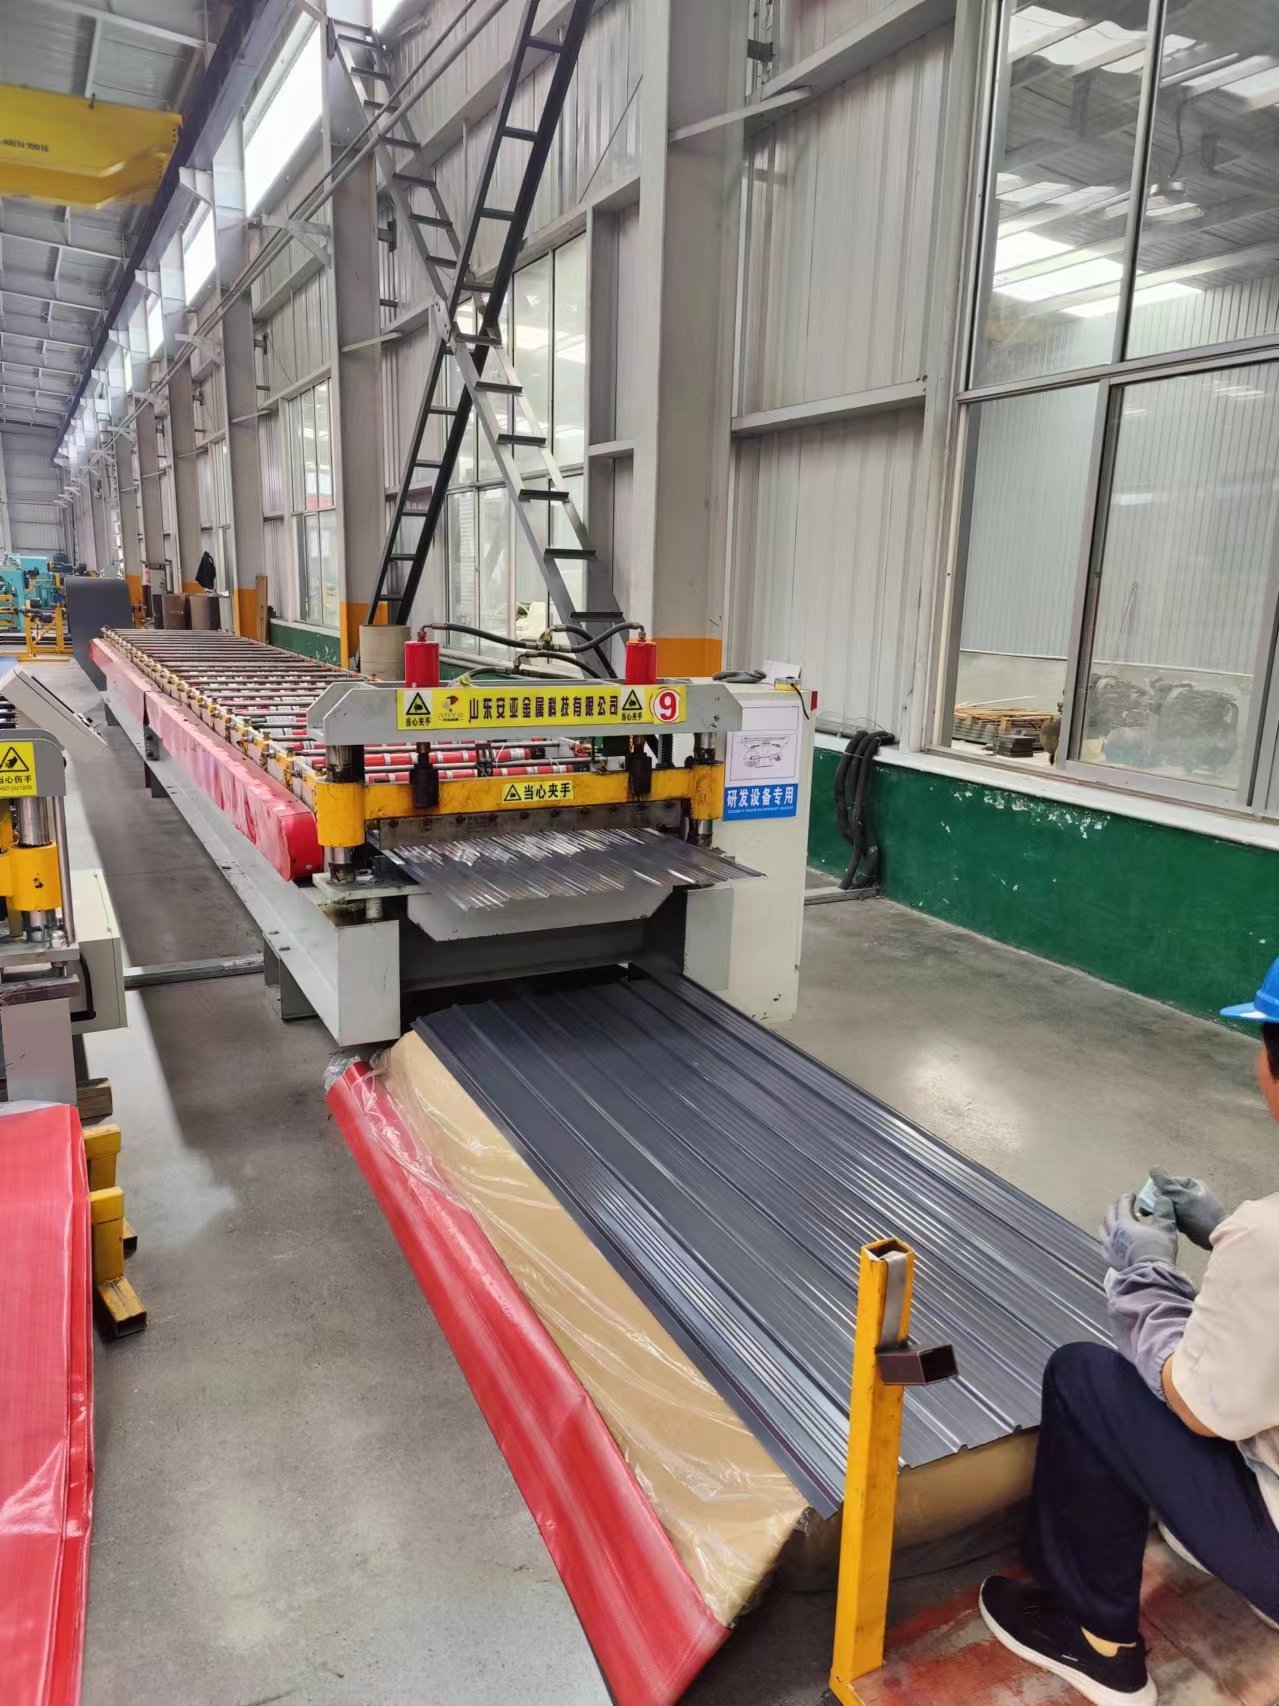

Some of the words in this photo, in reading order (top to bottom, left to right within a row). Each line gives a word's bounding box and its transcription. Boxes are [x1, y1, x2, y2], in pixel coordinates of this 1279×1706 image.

[469, 696, 618, 719] 山东安亚金属科技有限公司
[659, 692, 677, 720] 9
[405, 717, 431, 726] 当心夹手
[621, 712, 643, 721] 当心夹手
[524, 783, 571, 800] 当心夹手
[727, 787, 794, 808] 研发设备专用
